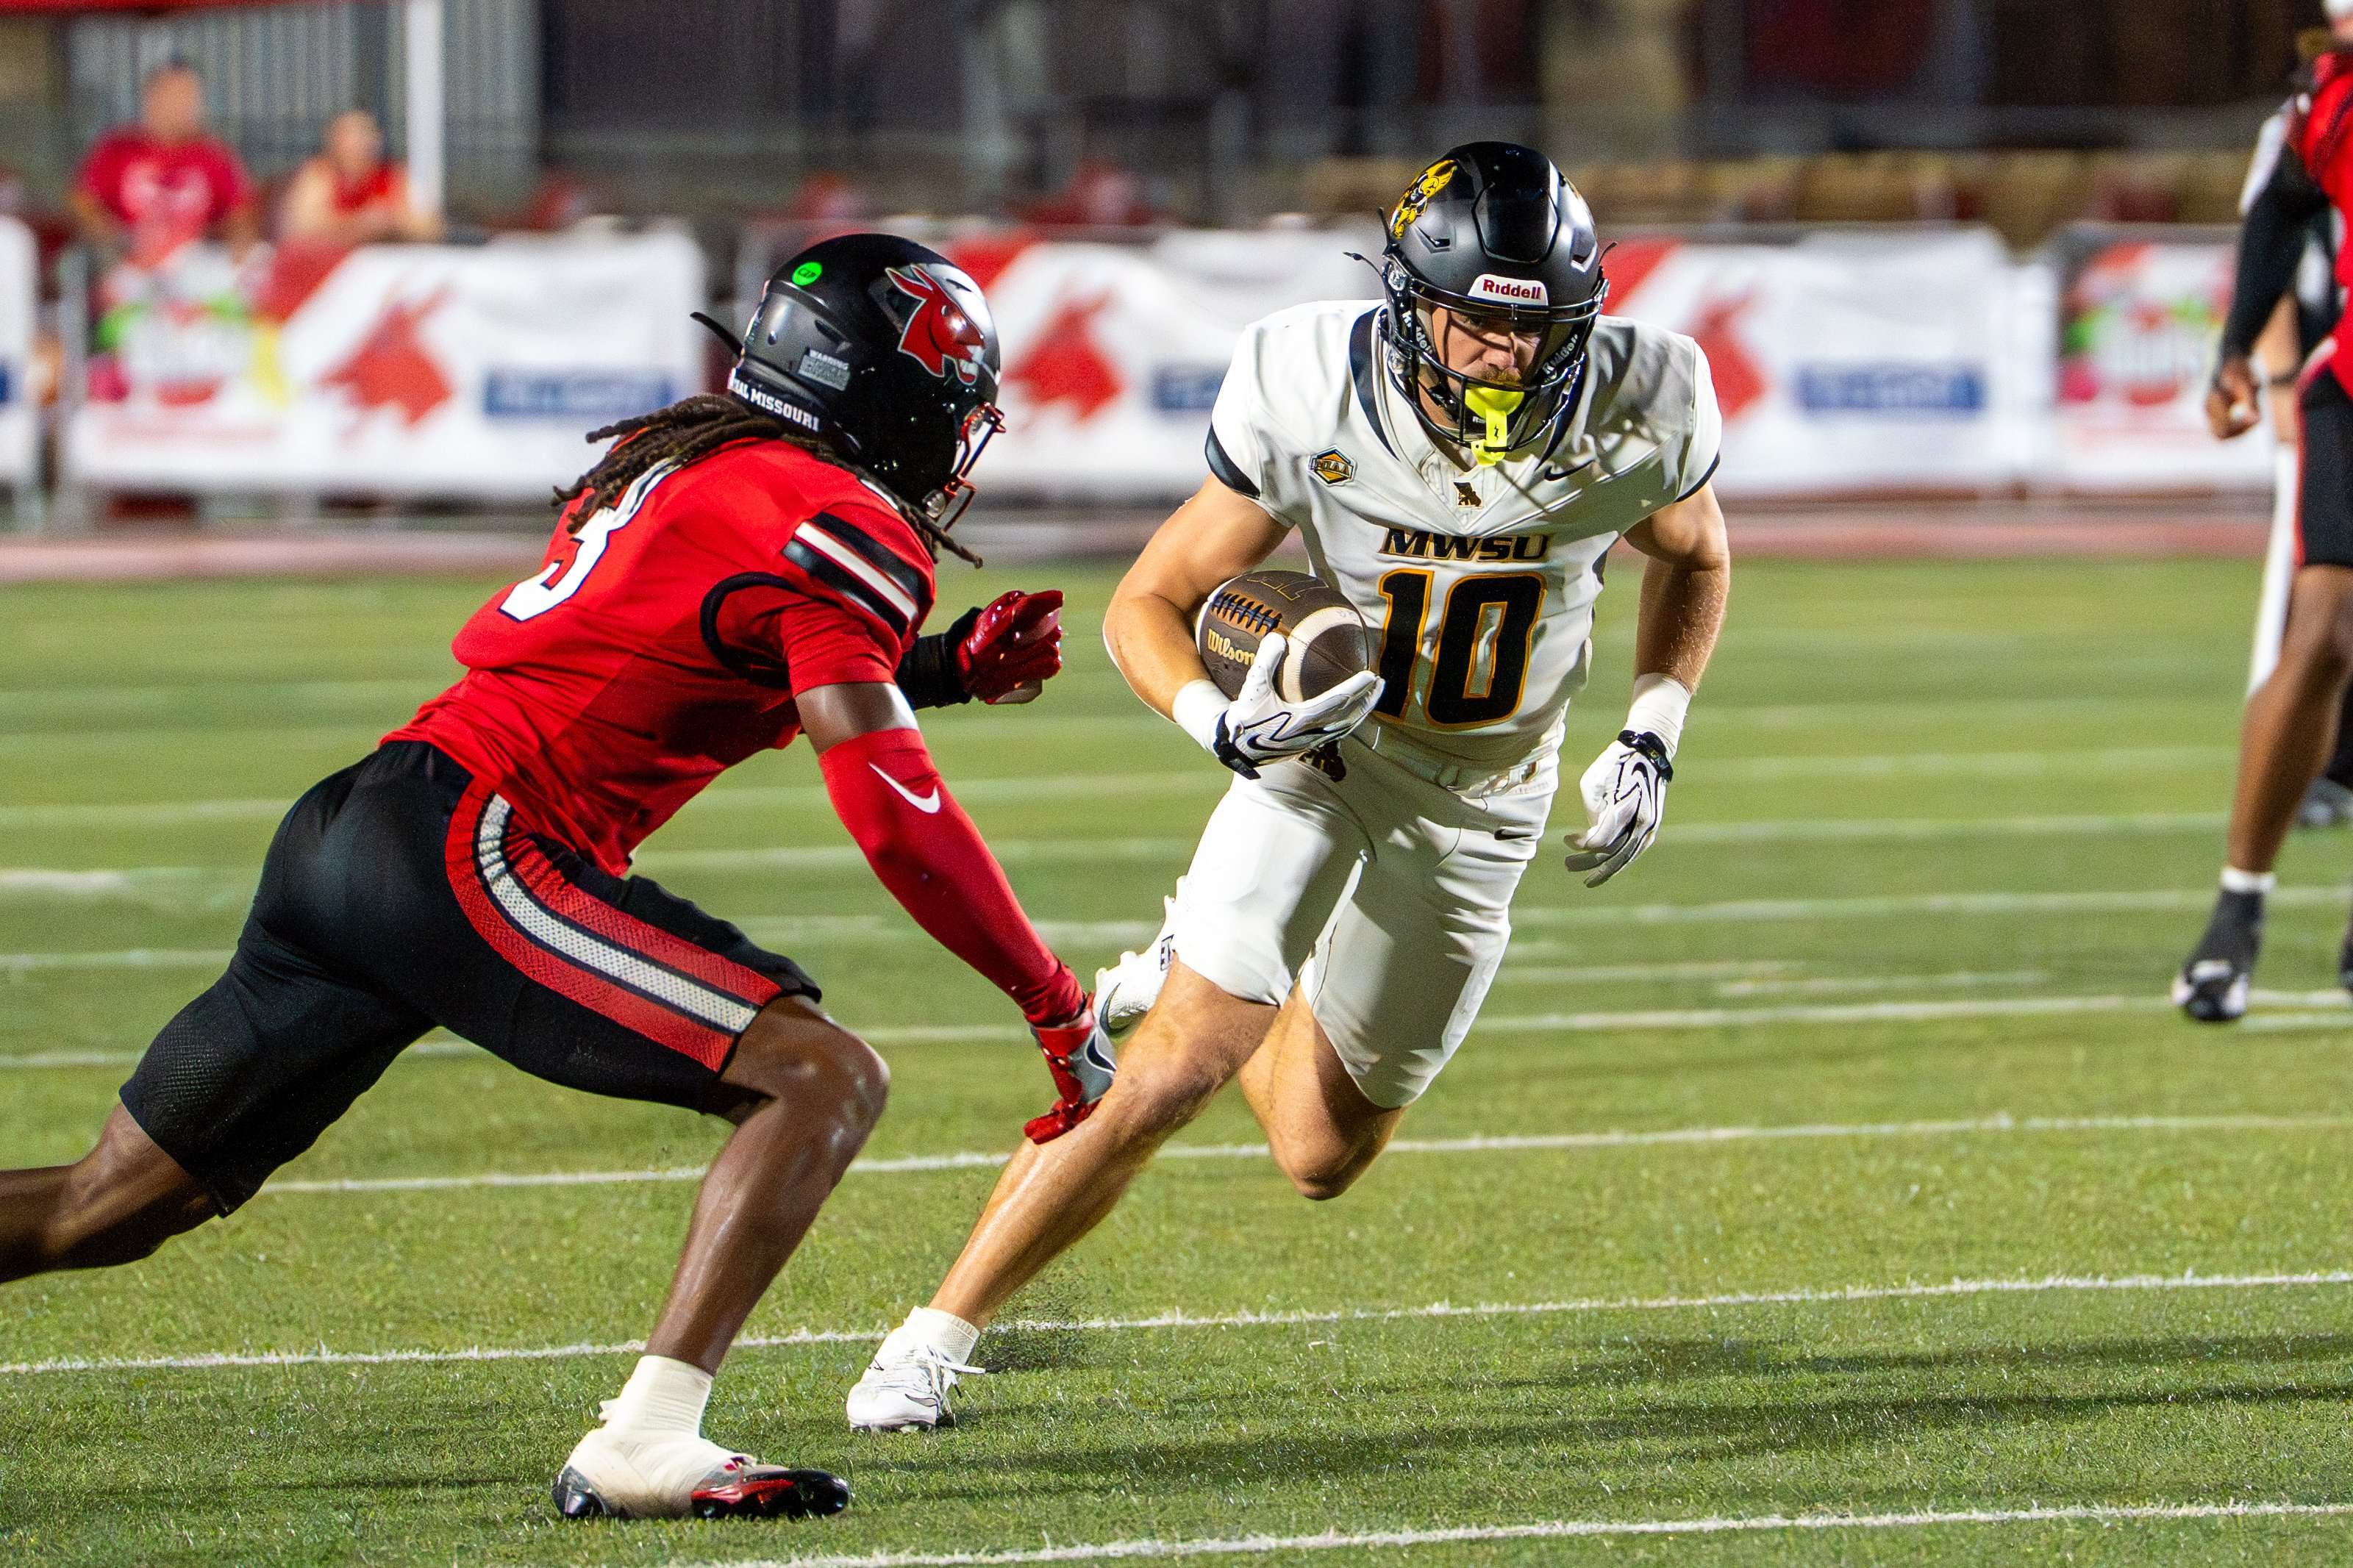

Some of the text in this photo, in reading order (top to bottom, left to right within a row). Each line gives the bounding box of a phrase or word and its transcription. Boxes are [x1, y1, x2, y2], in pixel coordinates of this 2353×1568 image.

[1482, 279, 1541, 300] Riddell
[750, 387, 820, 432] MISSOURI
[1378, 528, 1549, 562] MWSU
[1207, 628, 1255, 666] Wilson
[1373, 568, 1548, 731] 10
